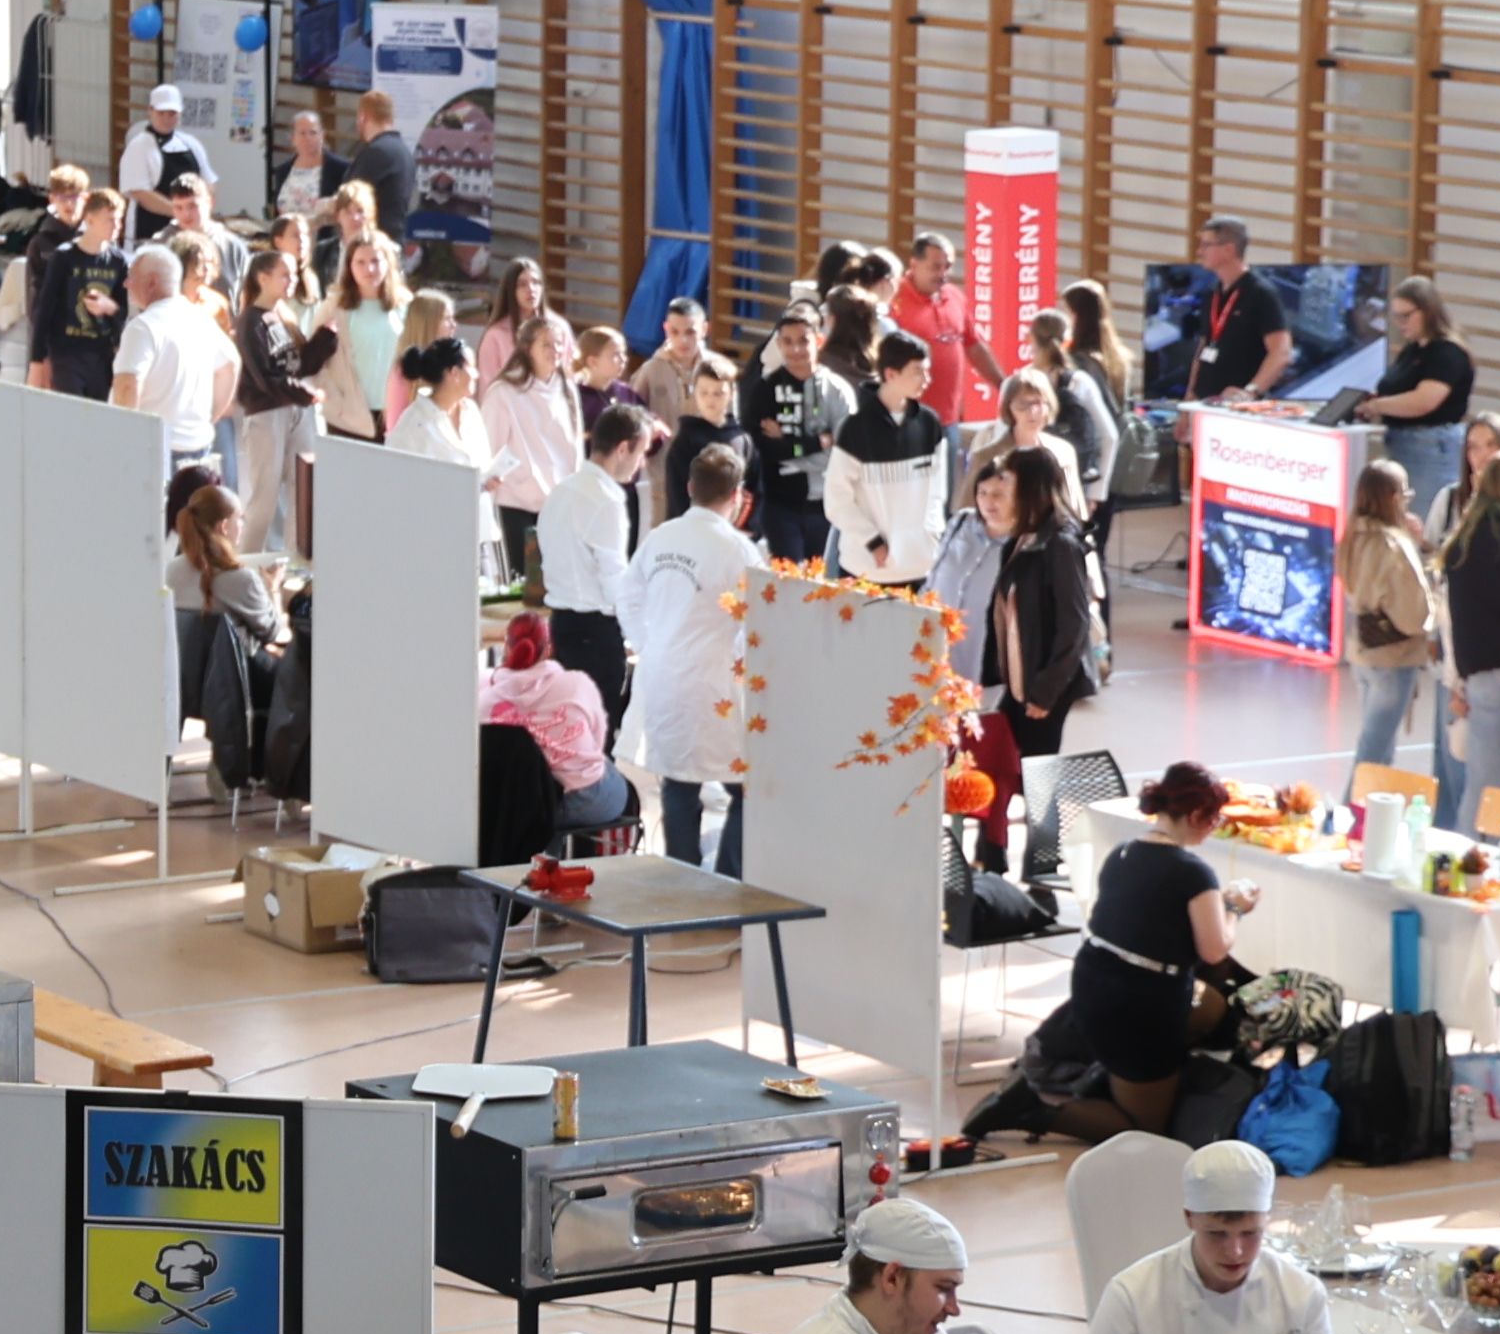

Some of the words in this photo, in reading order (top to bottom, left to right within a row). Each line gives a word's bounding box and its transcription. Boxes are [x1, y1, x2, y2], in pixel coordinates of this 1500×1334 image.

[972, 202, 993, 401] JZBERÉNY
[1208, 437, 1329, 483] Rosenberger
[103, 1138, 266, 1194] SZAKÁCS
